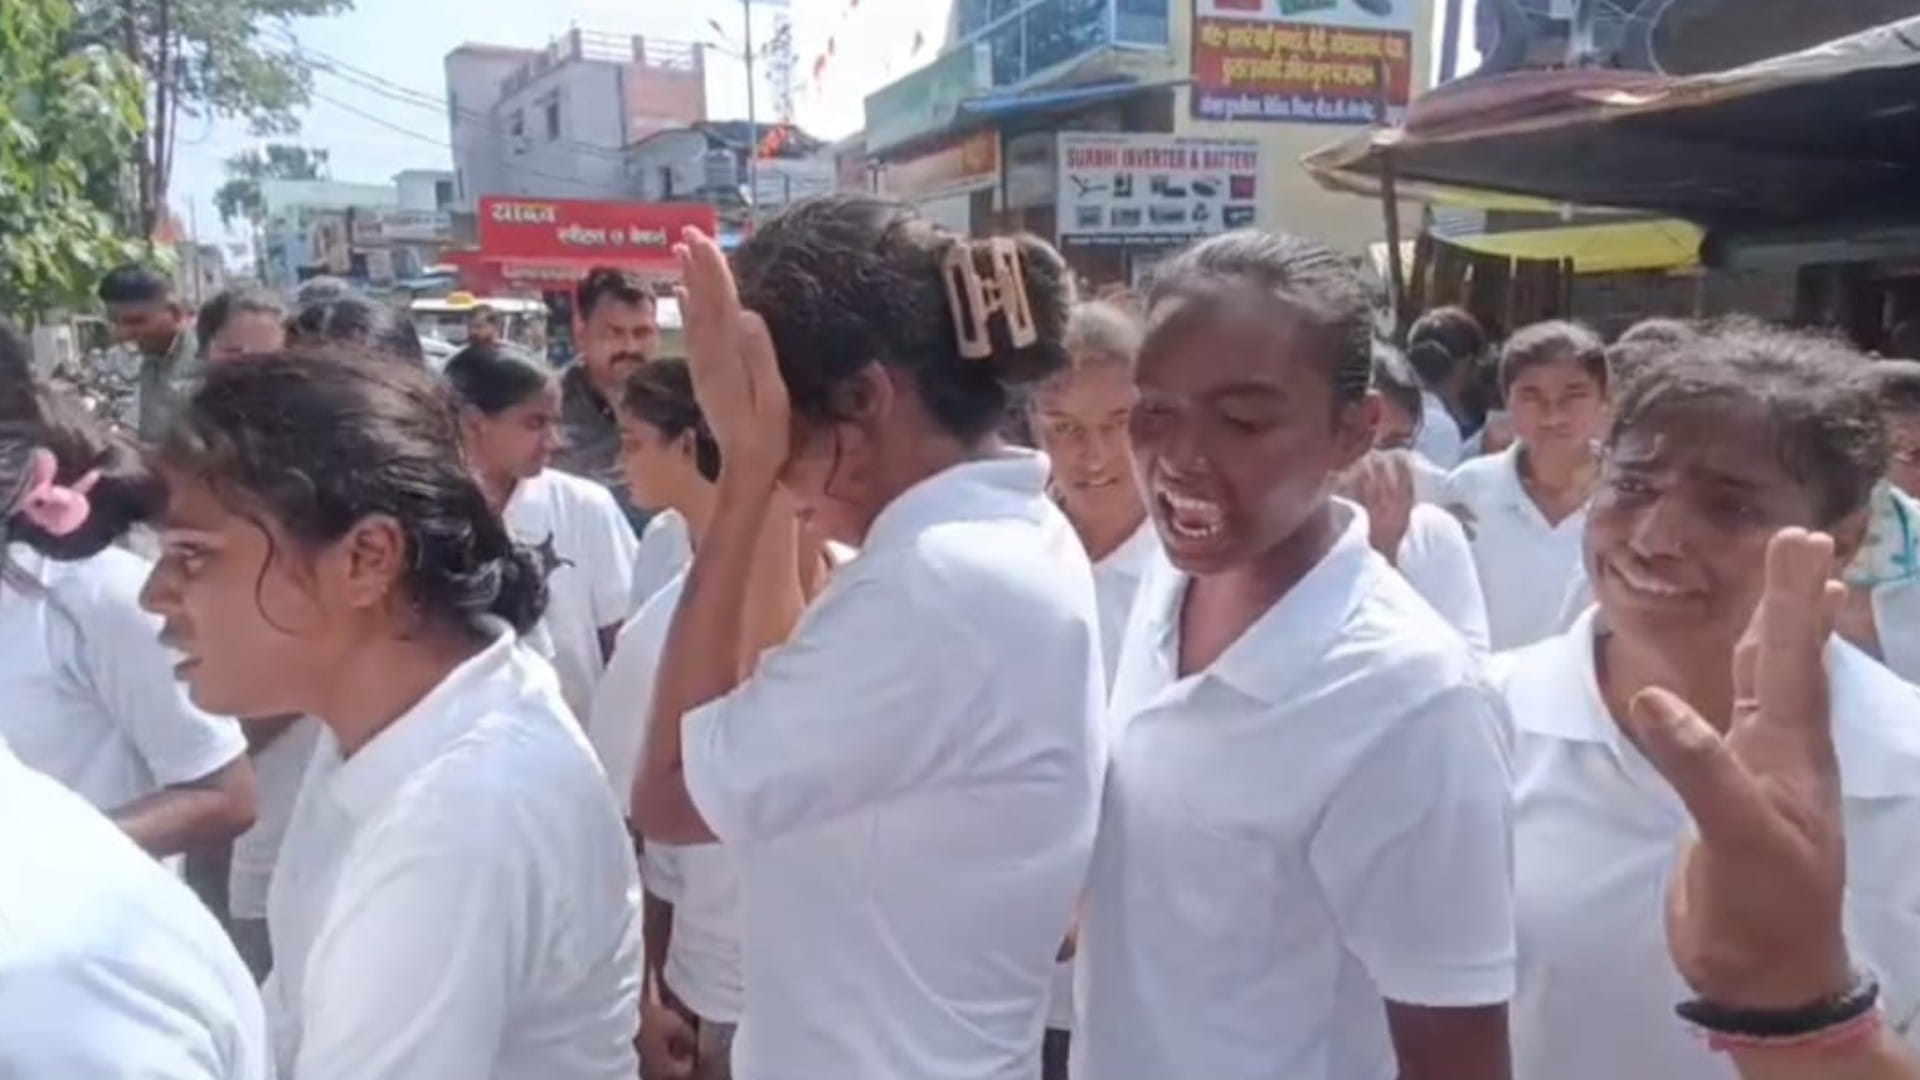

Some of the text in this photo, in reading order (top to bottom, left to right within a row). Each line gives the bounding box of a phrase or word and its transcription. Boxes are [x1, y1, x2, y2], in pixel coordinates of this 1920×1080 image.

[1066, 147, 1117, 169] SURBHI
[1122, 147, 1185, 170] INVERTER
[1203, 150, 1258, 169] BATTERY
